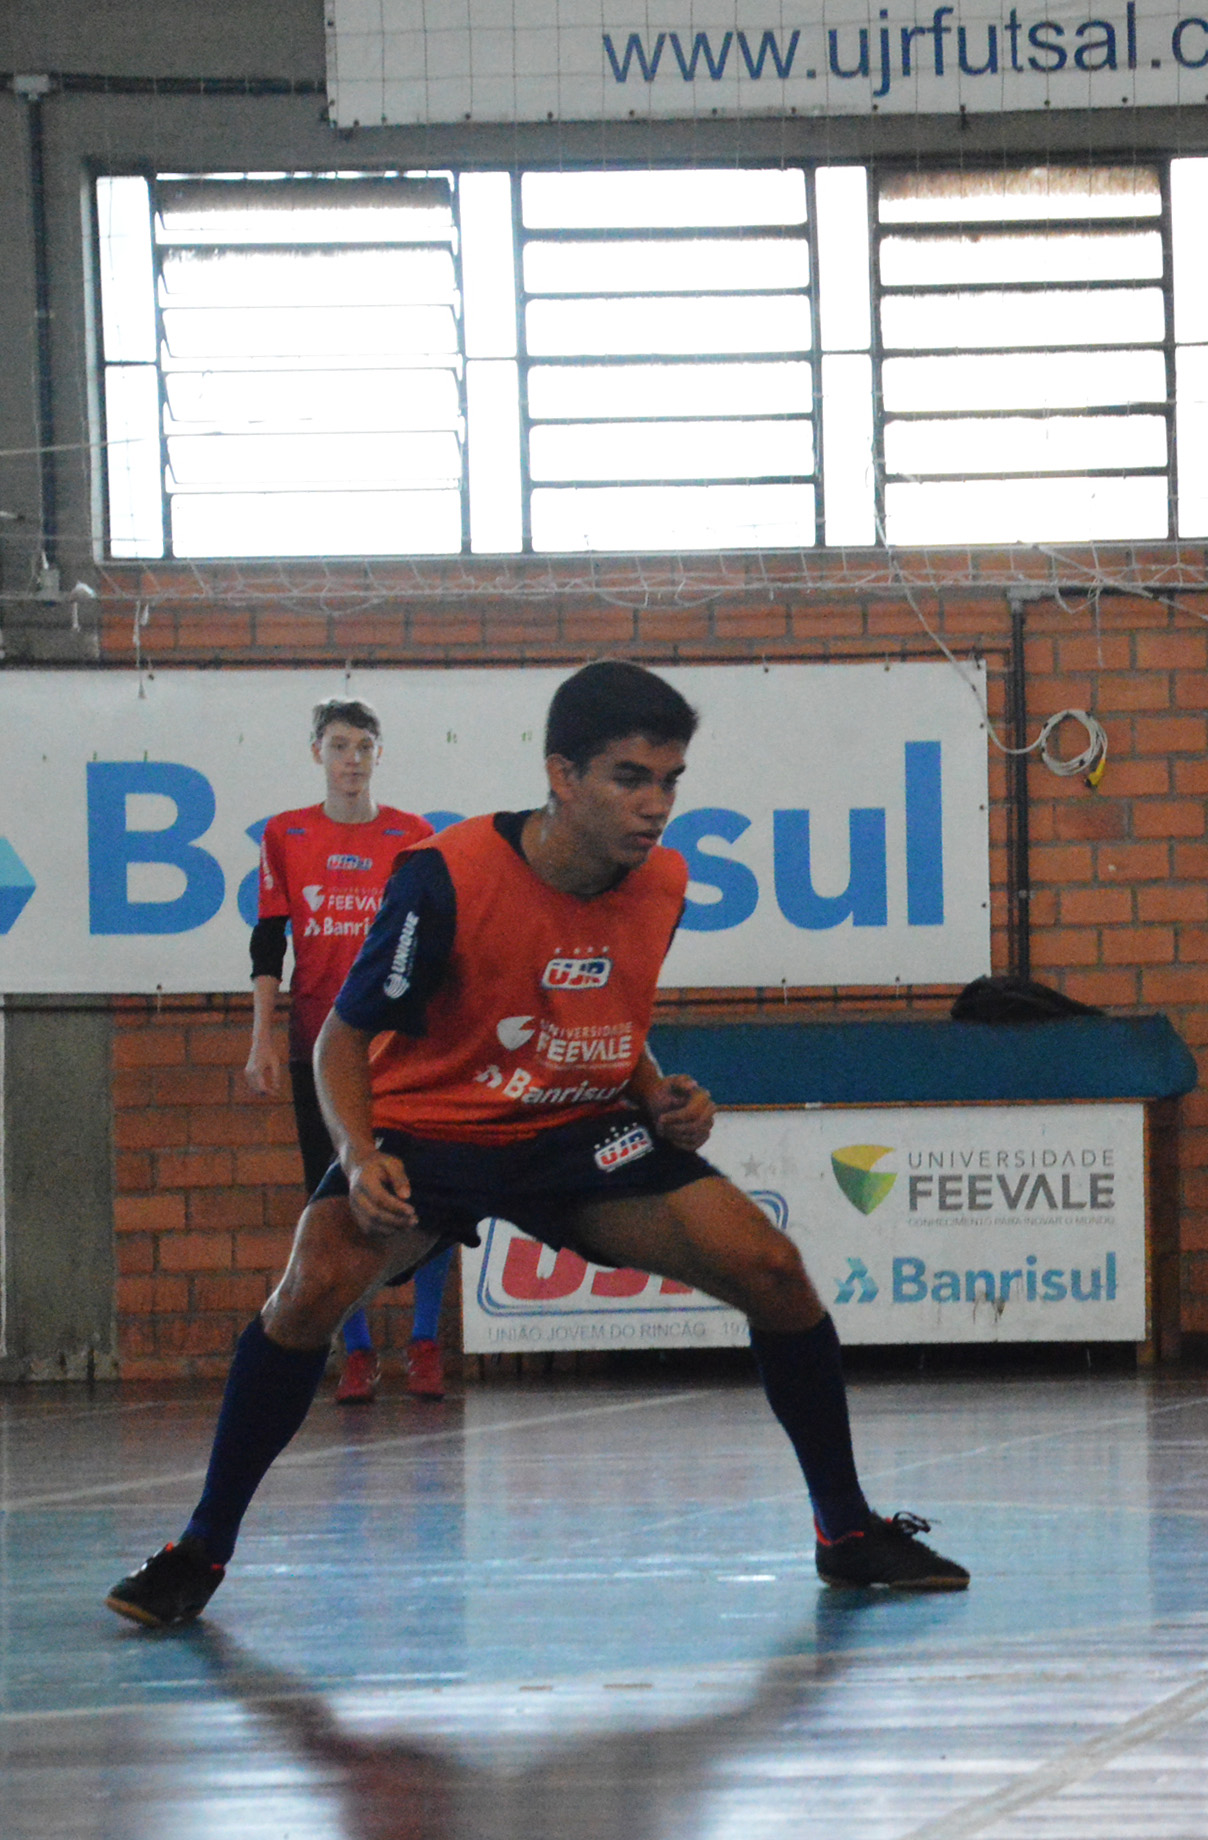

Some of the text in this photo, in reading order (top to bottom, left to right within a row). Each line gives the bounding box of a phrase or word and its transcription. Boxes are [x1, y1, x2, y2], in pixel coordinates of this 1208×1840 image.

[324, 917, 371, 937] Banri
[536, 1030, 633, 1063] FEEVALE
[908, 1149, 1115, 1170] UNIVERSIDADE
[908, 1172, 1116, 1212] FEEVALE
[891, 1251, 1118, 1304] Banrisul
[547, 1323, 606, 1341] JOVEM
[610, 1322, 636, 1339] DO
